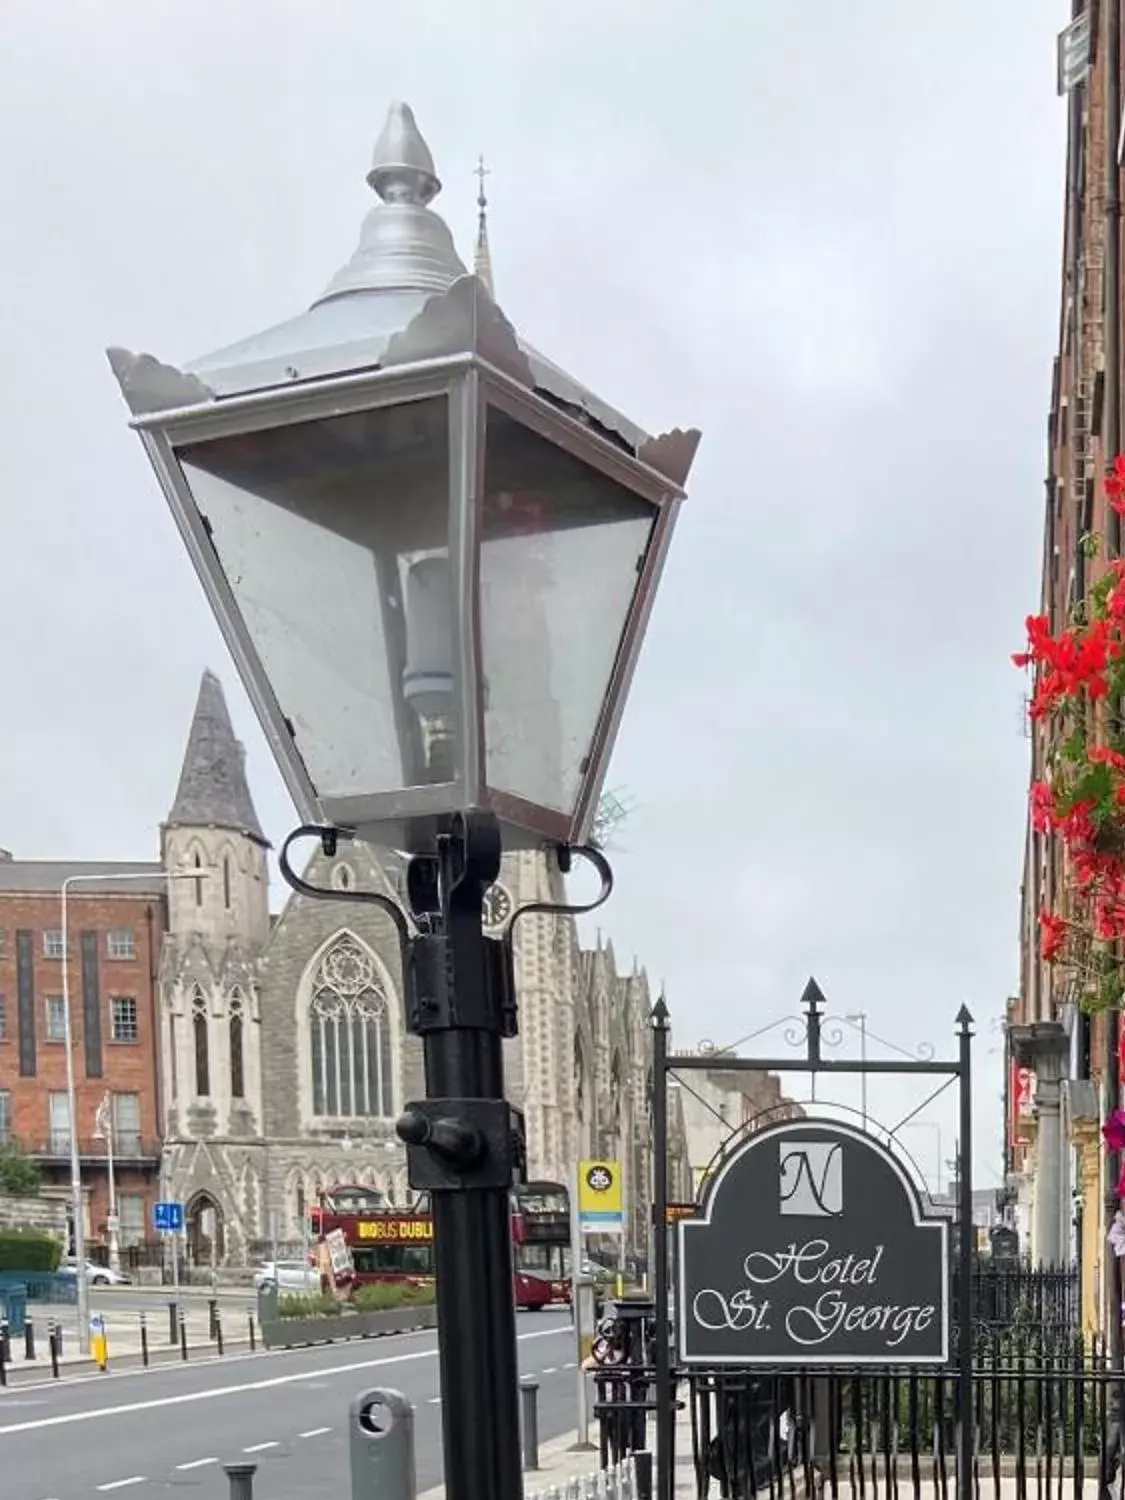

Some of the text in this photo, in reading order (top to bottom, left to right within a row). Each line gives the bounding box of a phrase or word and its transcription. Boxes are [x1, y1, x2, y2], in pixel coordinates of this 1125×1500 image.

[743, 1239, 884, 1285] Hotel
[693, 1289, 936, 1347] St. George
